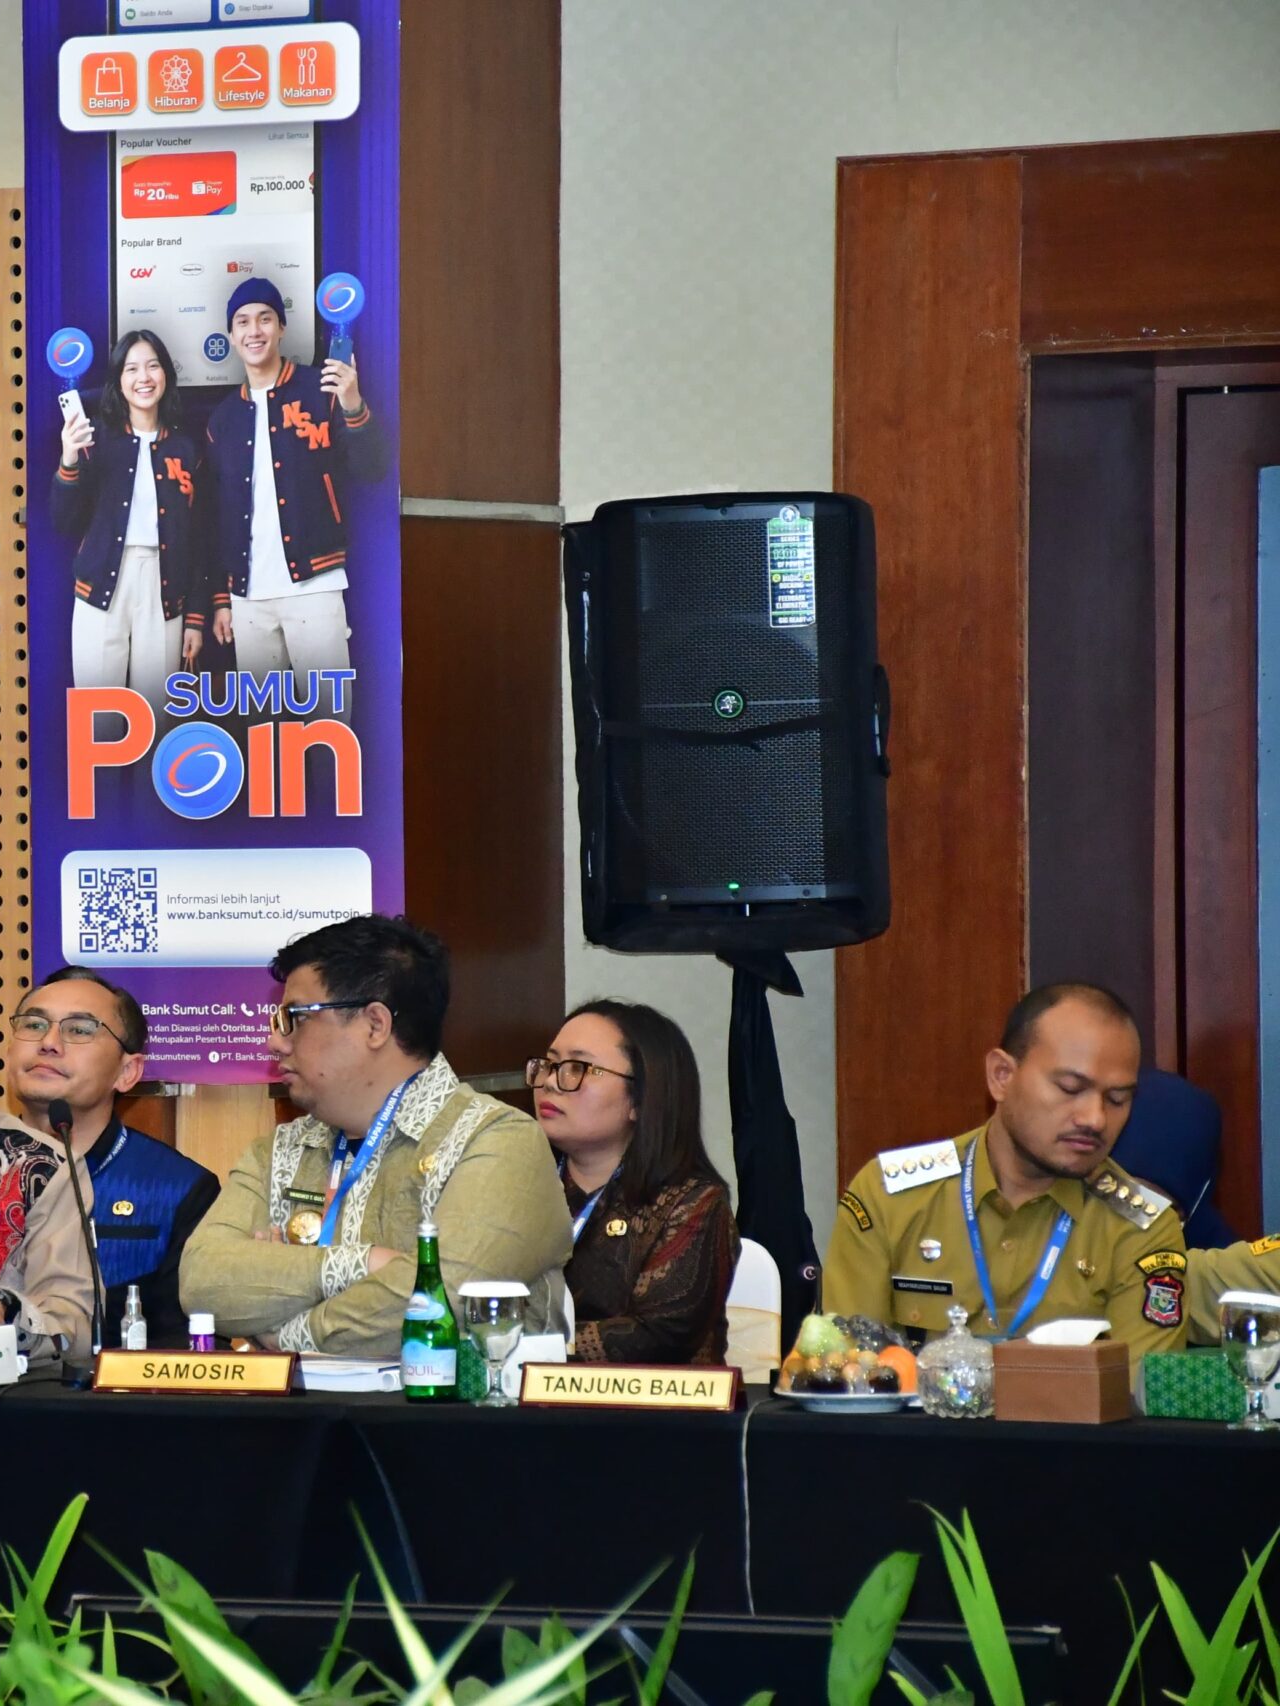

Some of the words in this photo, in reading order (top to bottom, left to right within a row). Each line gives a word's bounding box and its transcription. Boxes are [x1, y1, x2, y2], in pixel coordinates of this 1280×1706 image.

[218, 89, 265, 103] Lifestyle
[283, 86, 332, 98] Makanan
[88, 97, 130, 110] Belanja
[154, 95, 197, 107] Hiburan
[120, 138, 153, 150] Popular
[156, 137, 192, 147] Voucher
[134, 188, 145, 197] Rp
[250, 180, 305, 195] Rp.100.000
[121, 239, 154, 249] Popular
[157, 237, 182, 246] Brand
[130, 268, 153, 278] CGV
[164, 669, 357, 717] SUMUT
[167, 894, 217, 905] Informasi
[219, 893, 248, 905] lebih
[250, 892, 281, 908] lanjut
[167, 908, 360, 923] www.banksumut.co.id/sumutpoin
[142, 1004, 170, 1015] Bank
[172, 1004, 209, 1015] Sumut
[211, 1004, 236, 1015] Call:
[154, 1024, 169, 1032] dan
[171, 1024, 201, 1032] Diawasi
[202, 1024, 220, 1032] oleh
[221, 1024, 255, 1032] Otoritas
[149, 1035, 193, 1045] Merupakan
[195, 1035, 226, 1043] Peserta
[228, 1035, 266, 1045] Lembaga
[221, 1053, 234, 1061] PT.
[235, 1053, 255, 1061] Bank
[367, 1121, 385, 1147] RAPAT
[381, 1098, 396, 1122] UMUM
[965, 1194, 975, 1221] RAPAT
[142, 1362, 246, 1381] SAMOSIR
[542, 1375, 641, 1396] TANJUNG
[649, 1379, 715, 1397] BALAI
